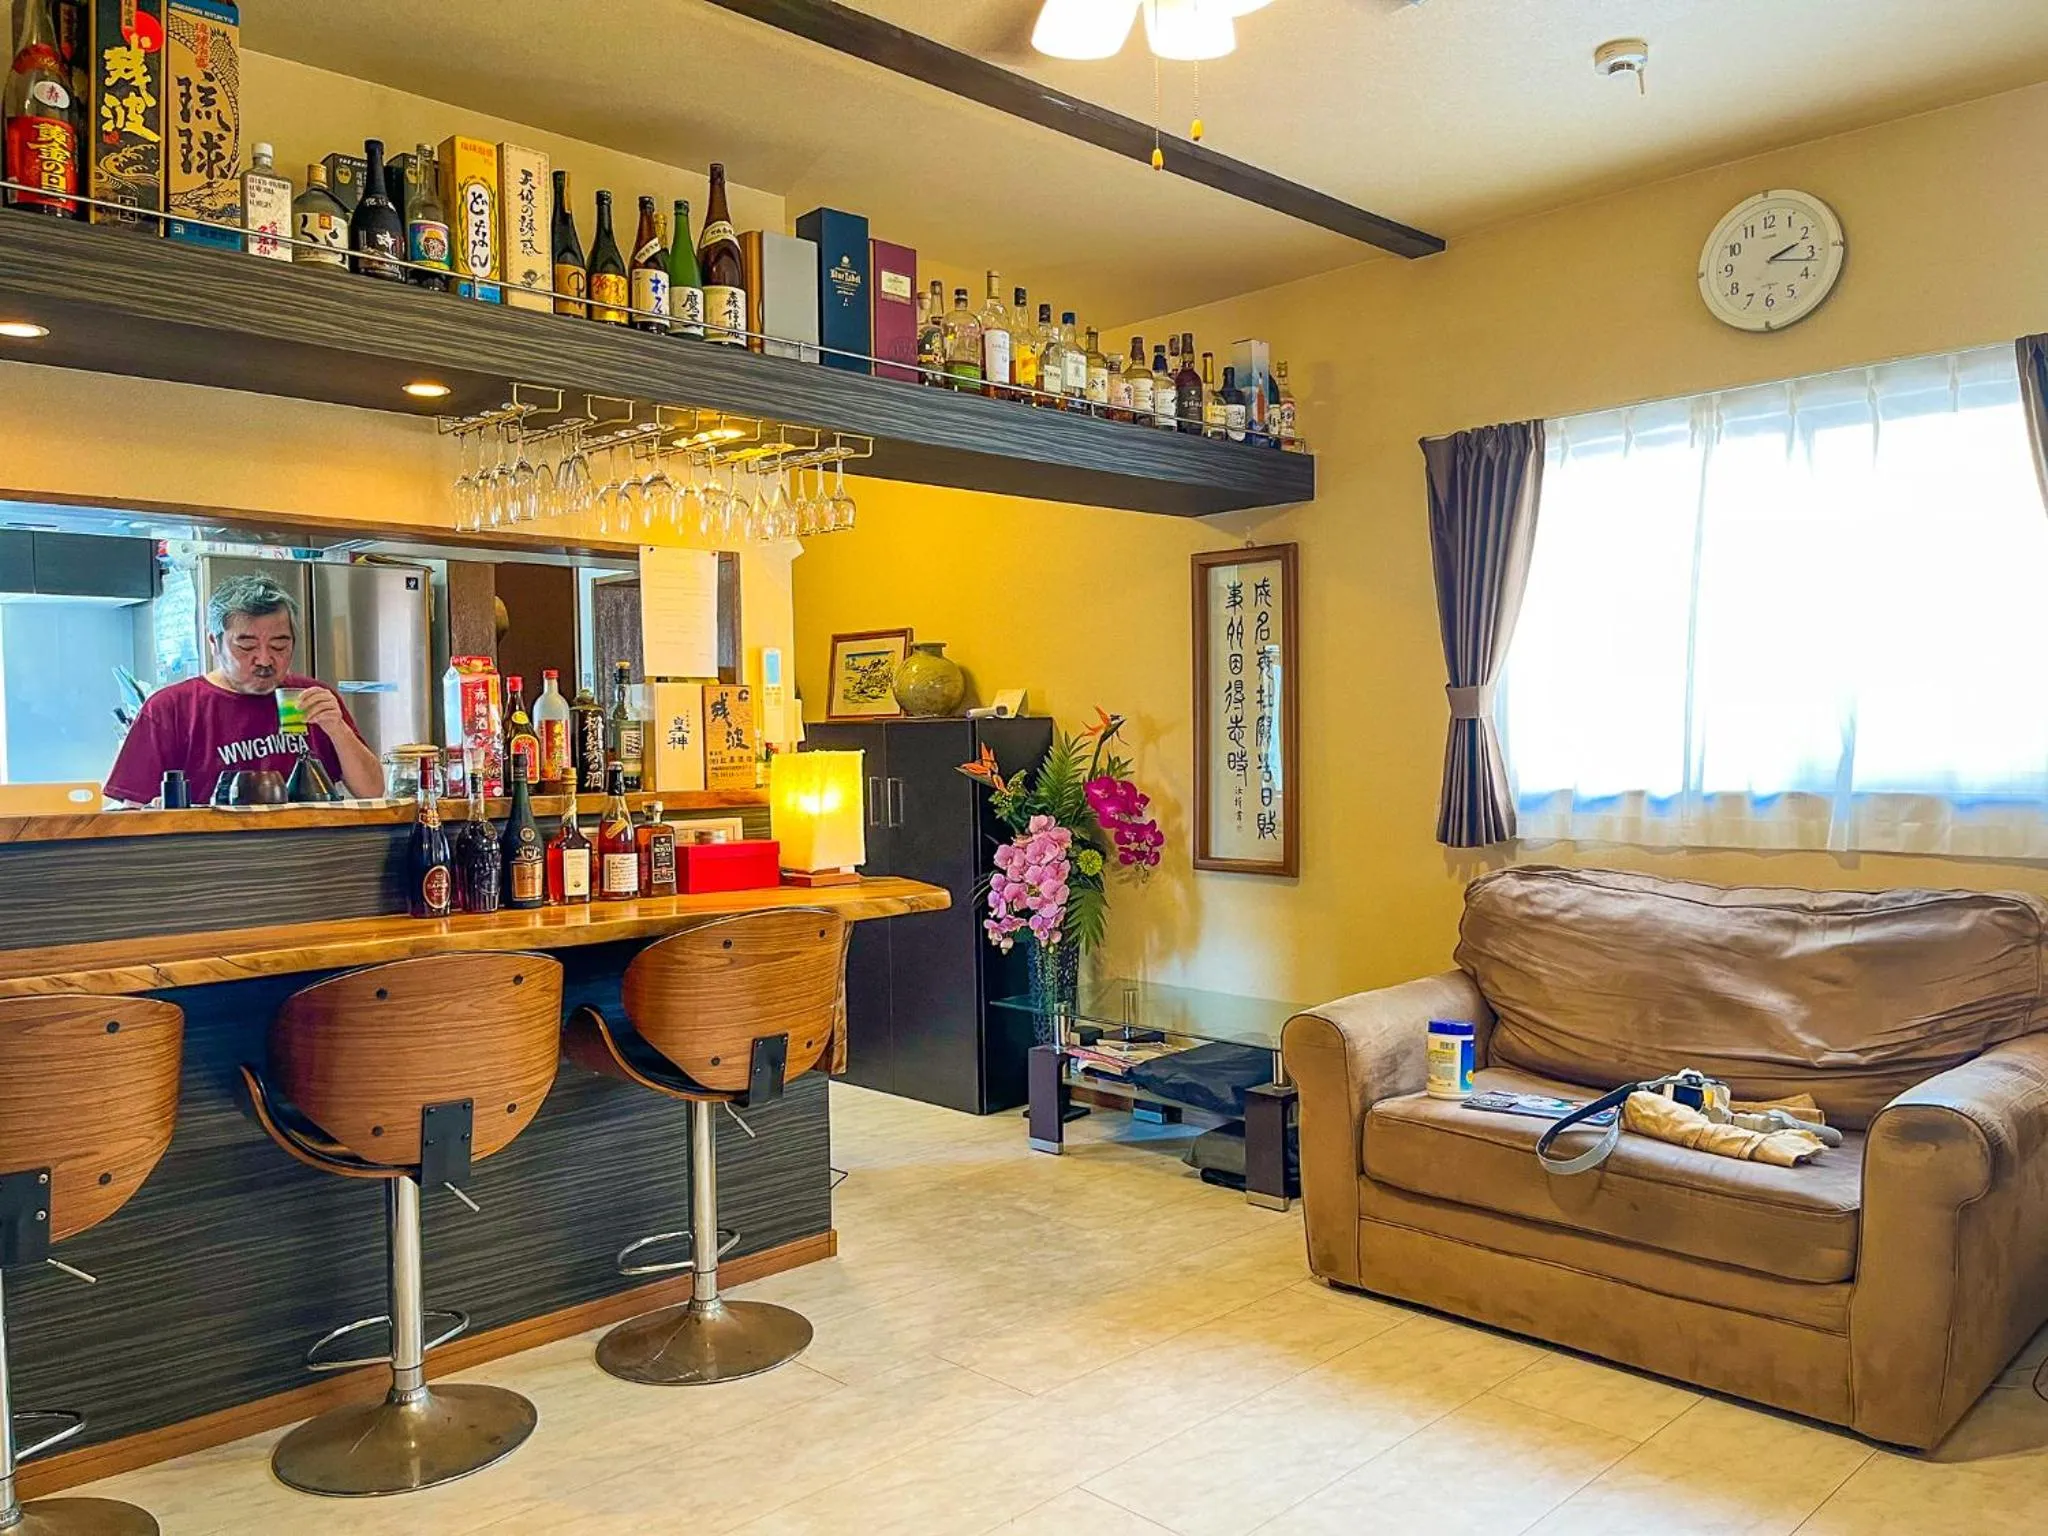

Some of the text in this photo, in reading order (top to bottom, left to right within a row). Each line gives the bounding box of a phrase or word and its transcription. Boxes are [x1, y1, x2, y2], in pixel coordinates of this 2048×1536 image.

[517, 168, 543, 257] 天使の誘惑
[469, 191, 489, 268] どなん
[1763, 215, 1776, 230] 12
[1743, 225, 1755, 239] 11
[1800, 226, 1809, 240] 2
[1729, 242, 1742, 257] 10
[1807, 245, 1815, 259] 3
[1724, 263, 1734, 278] 9
[1800, 266, 1809, 280] 4
[1730, 282, 1739, 296] 8
[1786, 284, 1795, 298] 5
[1743, 293, 1755, 310] 7
[1765, 293, 1775, 308] 6
[711, 692, 750, 750] 残波
[667, 716, 691, 751] 皇神
[217, 734, 310, 765] WWG1WGA
